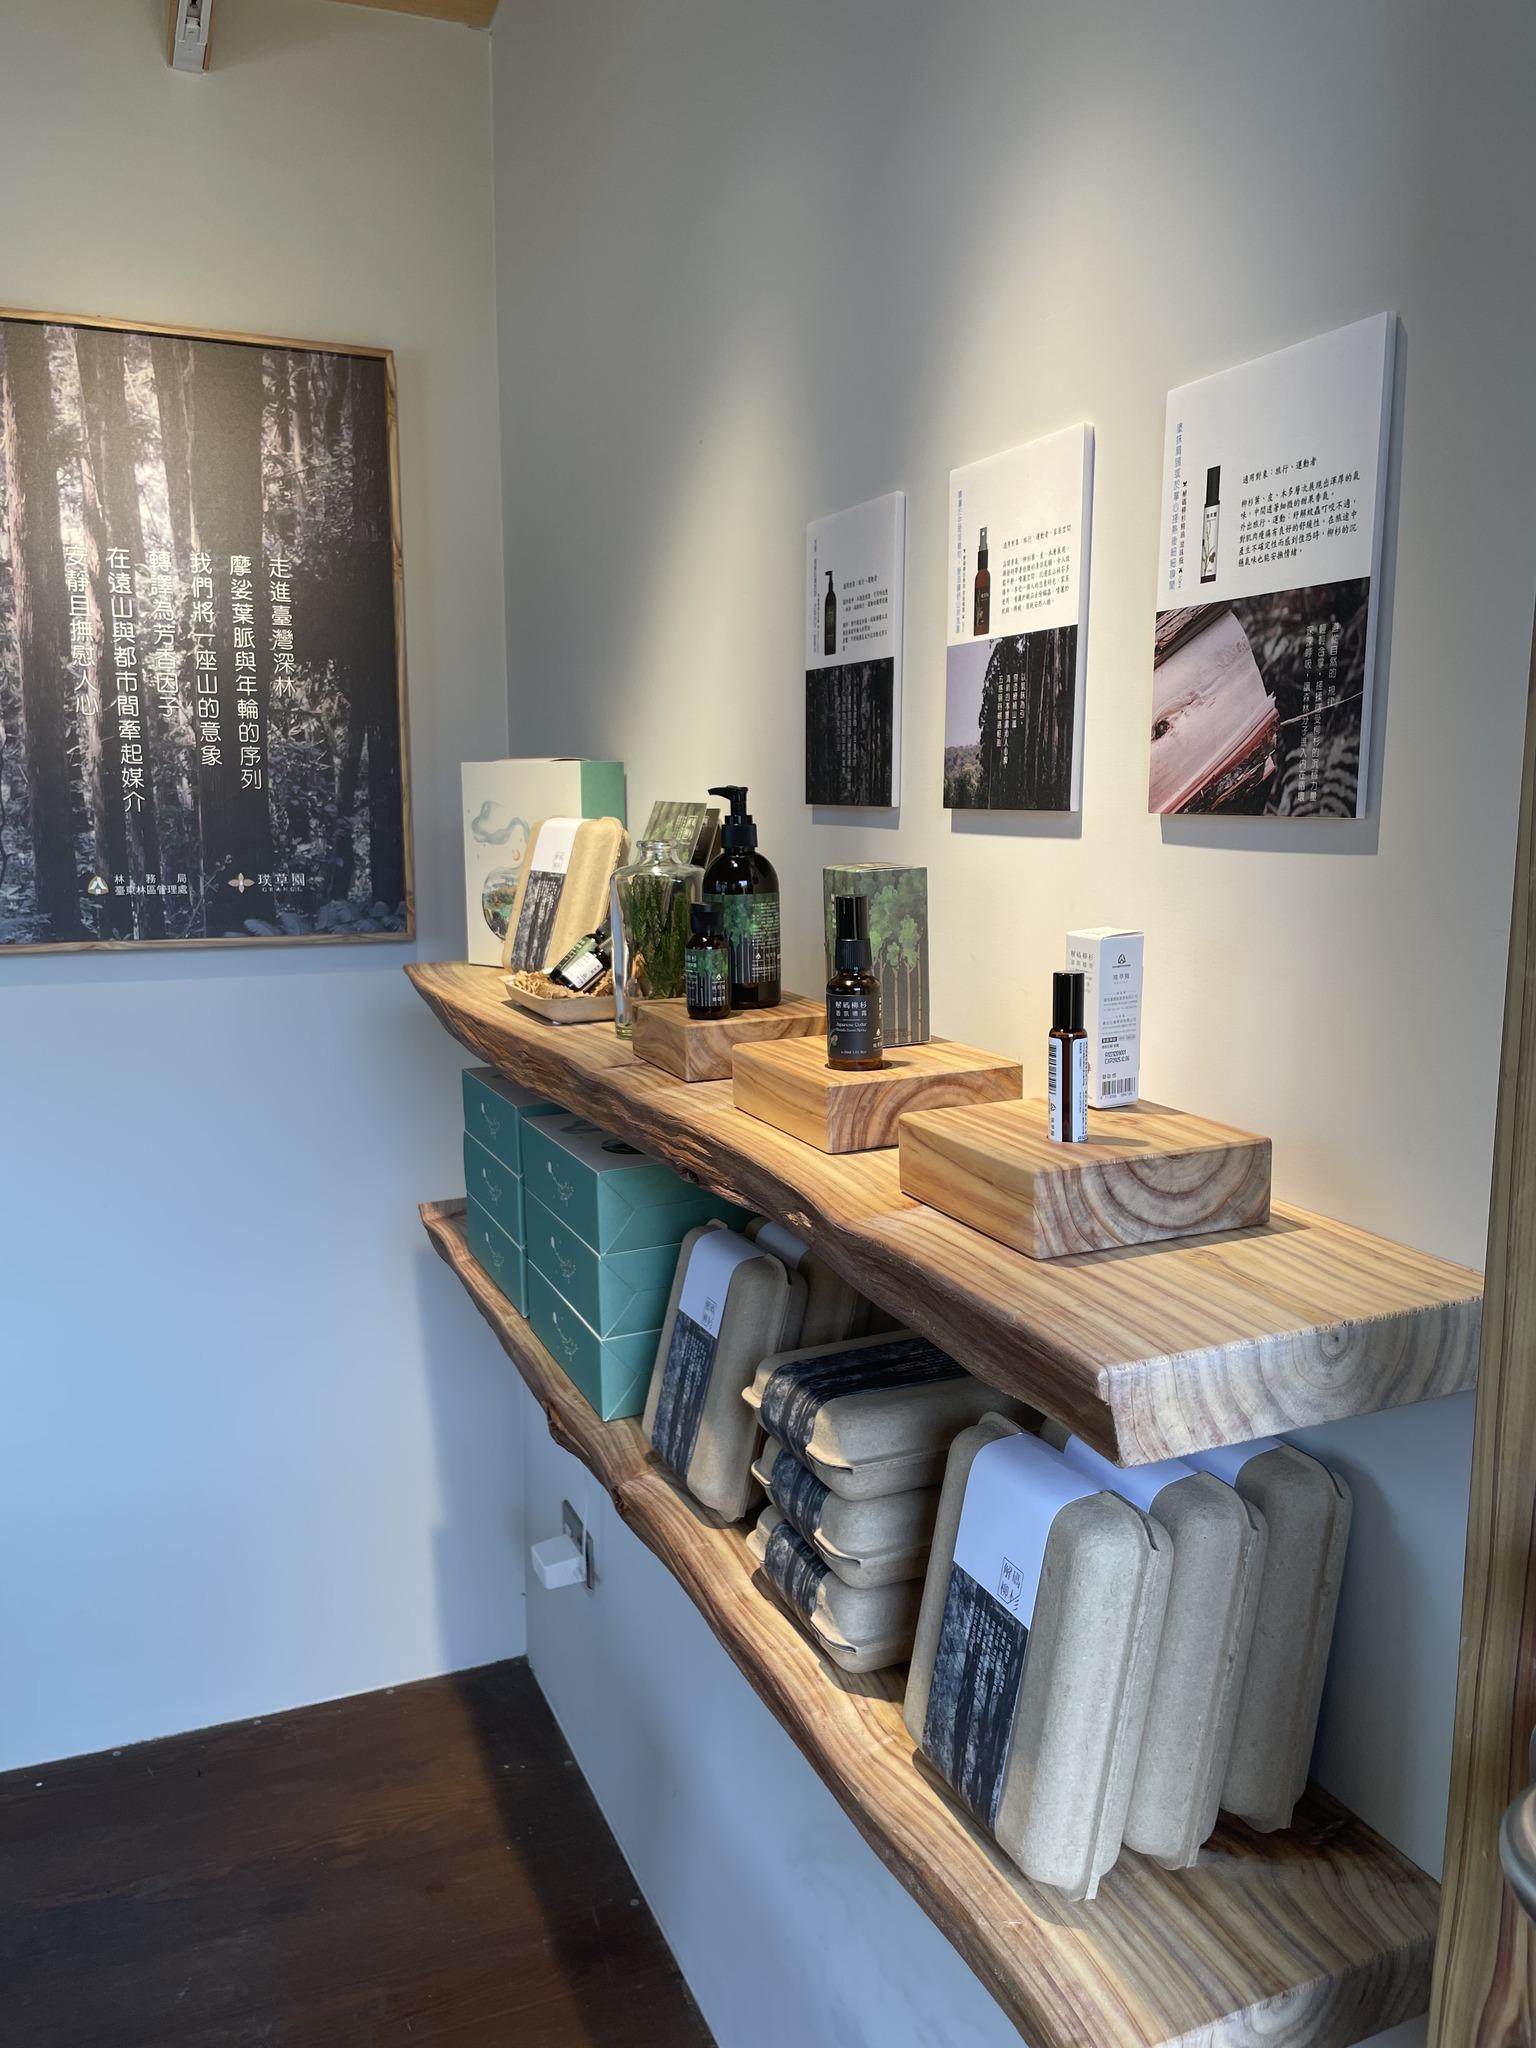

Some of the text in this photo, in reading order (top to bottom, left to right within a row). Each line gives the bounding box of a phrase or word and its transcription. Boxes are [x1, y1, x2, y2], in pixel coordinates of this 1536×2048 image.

[65, 545, 99, 717] 安靜且撫慰人心
[107, 546, 146, 813] 在遠山與都市間牽起媒介
[149, 550, 180, 718] 轉譯為芳香因子
[190, 552, 223, 767] 我們將一座山的意象
[229, 554, 262, 790] 摩娑葉脈與年輪的序列
[269, 558, 298, 697] 走進臺灣深林
[114, 884, 188, 896] 臺東林區管理處
